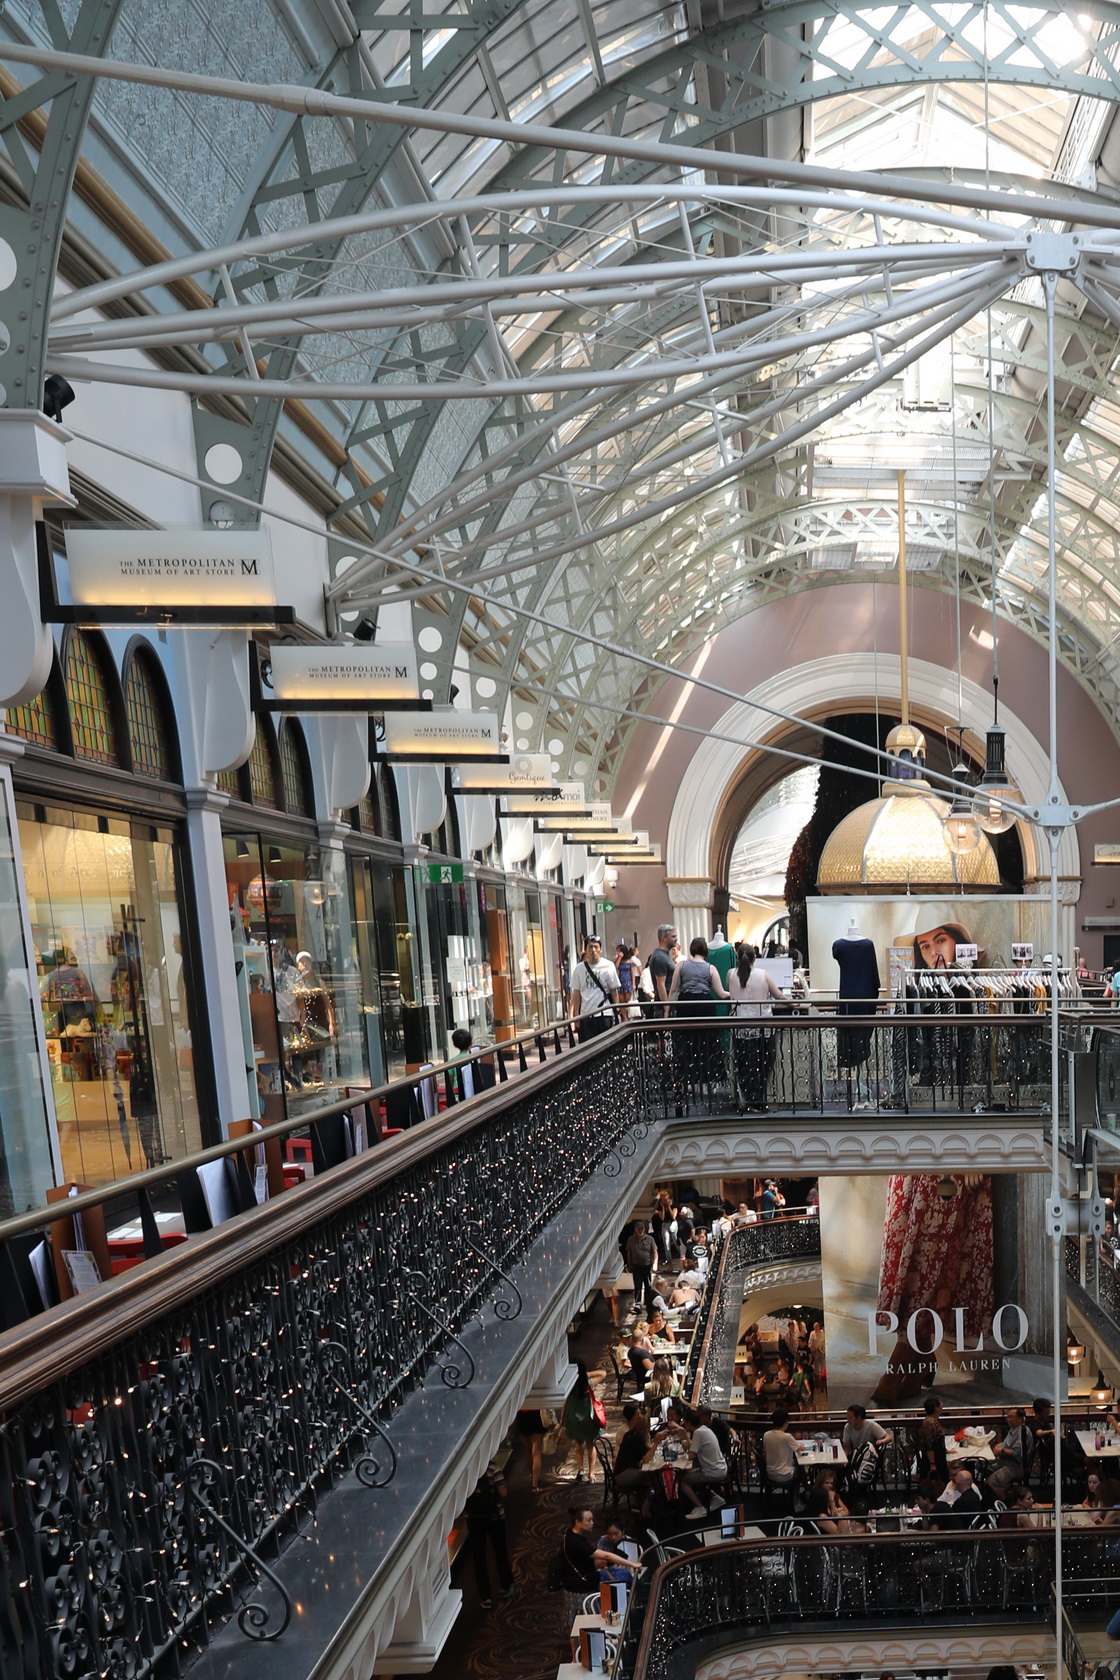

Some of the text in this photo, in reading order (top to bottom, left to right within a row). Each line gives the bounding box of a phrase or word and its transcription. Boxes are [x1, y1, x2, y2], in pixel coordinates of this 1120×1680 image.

[137, 559, 235, 567] METROPOLITAN
[241, 559, 258, 575] M
[395, 666, 408, 678] M
[481, 728, 491, 738] M
[508, 770, 545, 784] Gemtique
[866, 1303, 1029, 1357] POLO
[886, 1358, 1012, 1375] RALPH LAUREN
